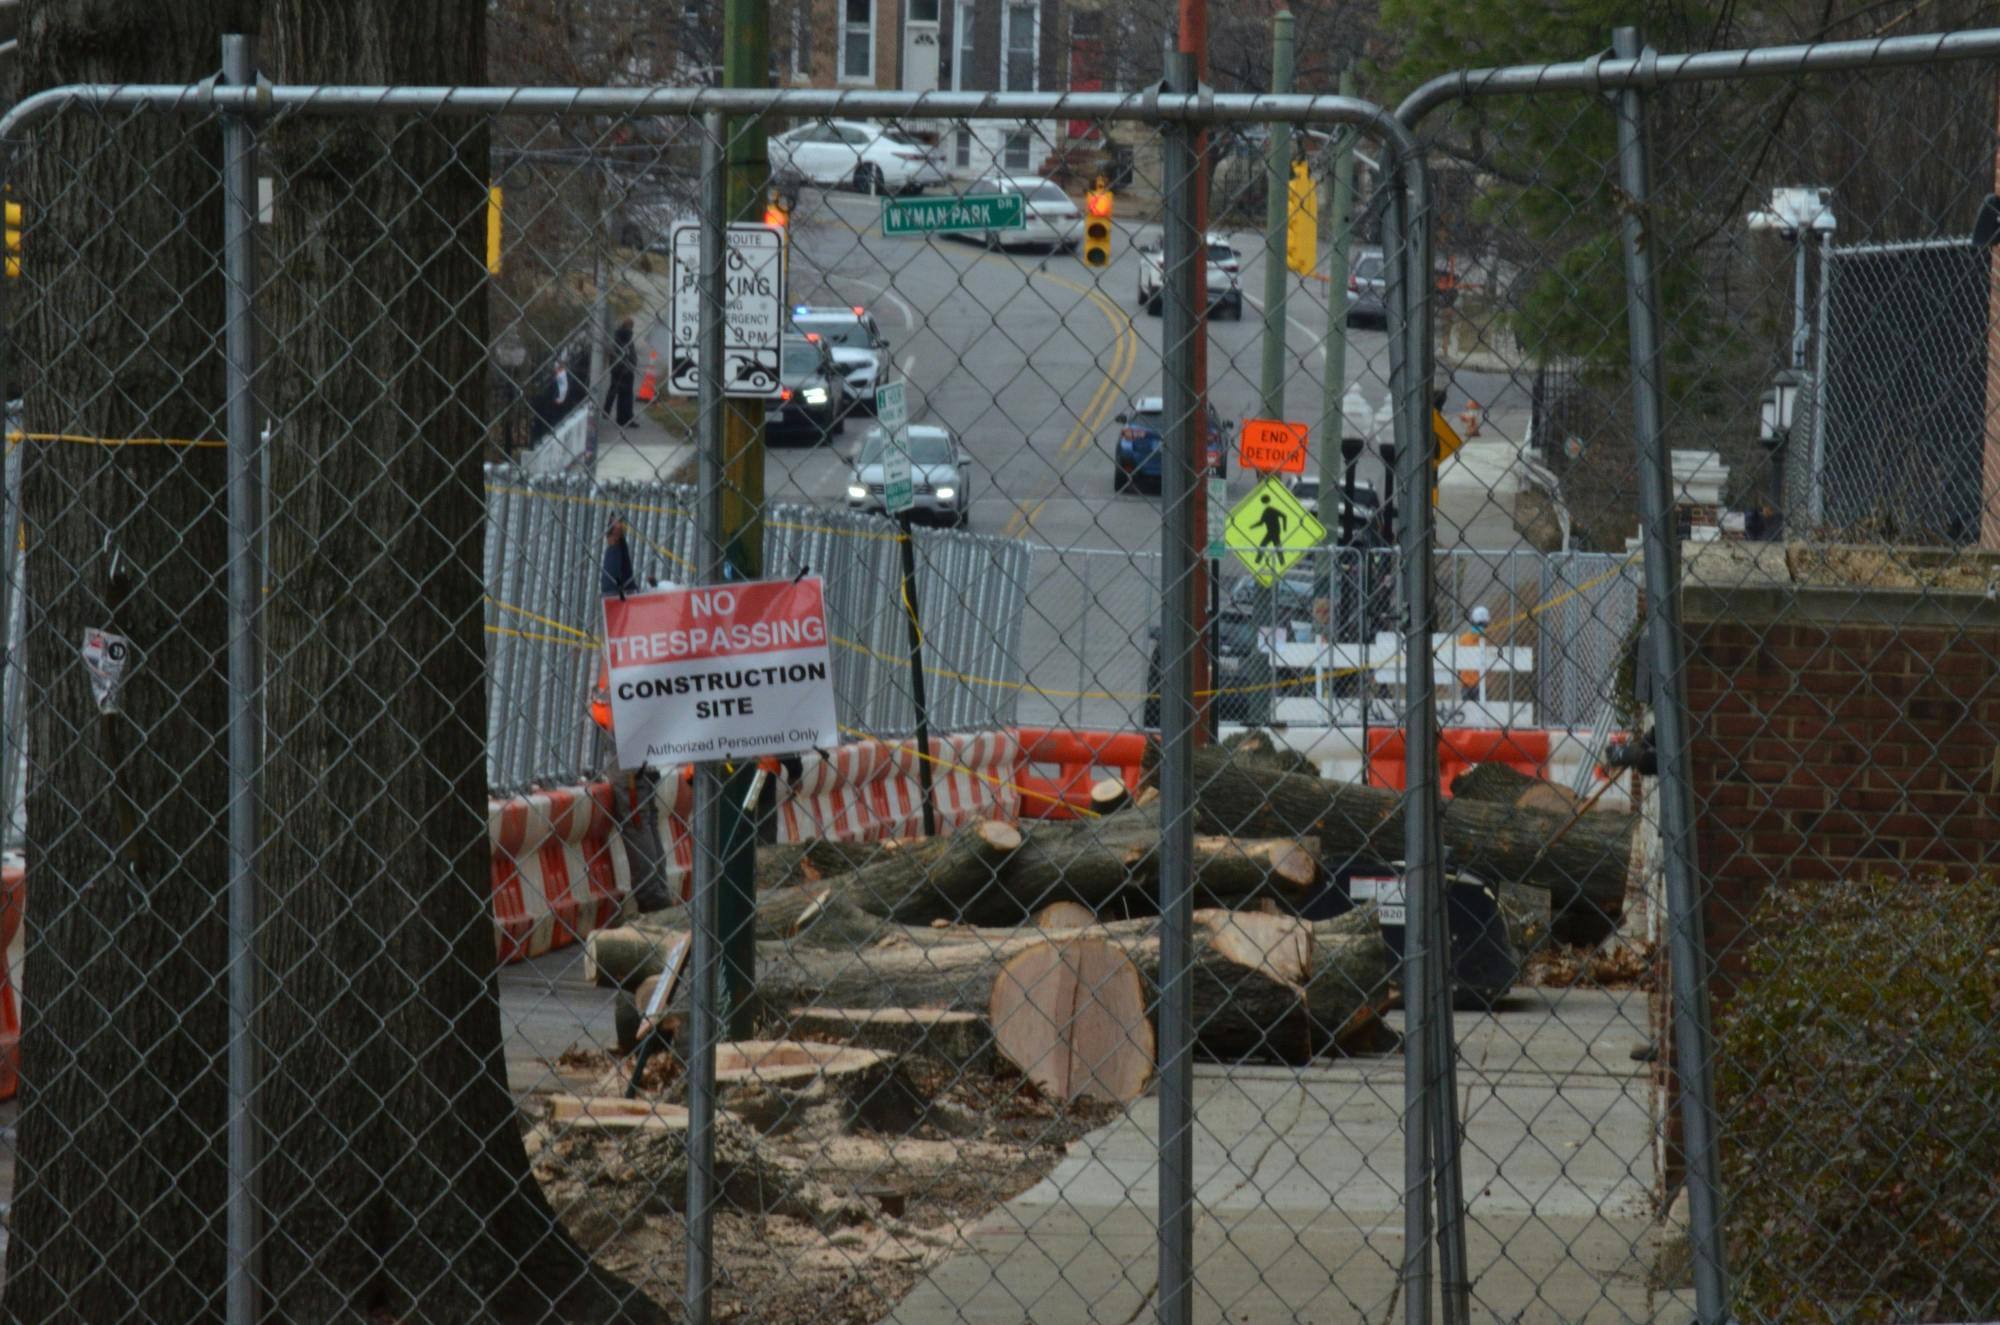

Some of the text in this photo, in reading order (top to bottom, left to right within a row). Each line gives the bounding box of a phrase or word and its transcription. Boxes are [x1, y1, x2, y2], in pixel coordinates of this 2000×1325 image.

[889, 206, 947, 228] WYMAN
[951, 204, 991, 226] PARK
[682, 325, 768, 343] 9 9 PM
[1260, 430, 1288, 445] END
[1246, 447, 1300, 464] DETOUR
[690, 591, 736, 620] NO
[609, 616, 825, 662] TRESPASSING
[617, 661, 827, 701] CONSTRUCTION
[696, 696, 754, 720] SITE
[646, 727, 820, 757] Authorized Personnel Only
